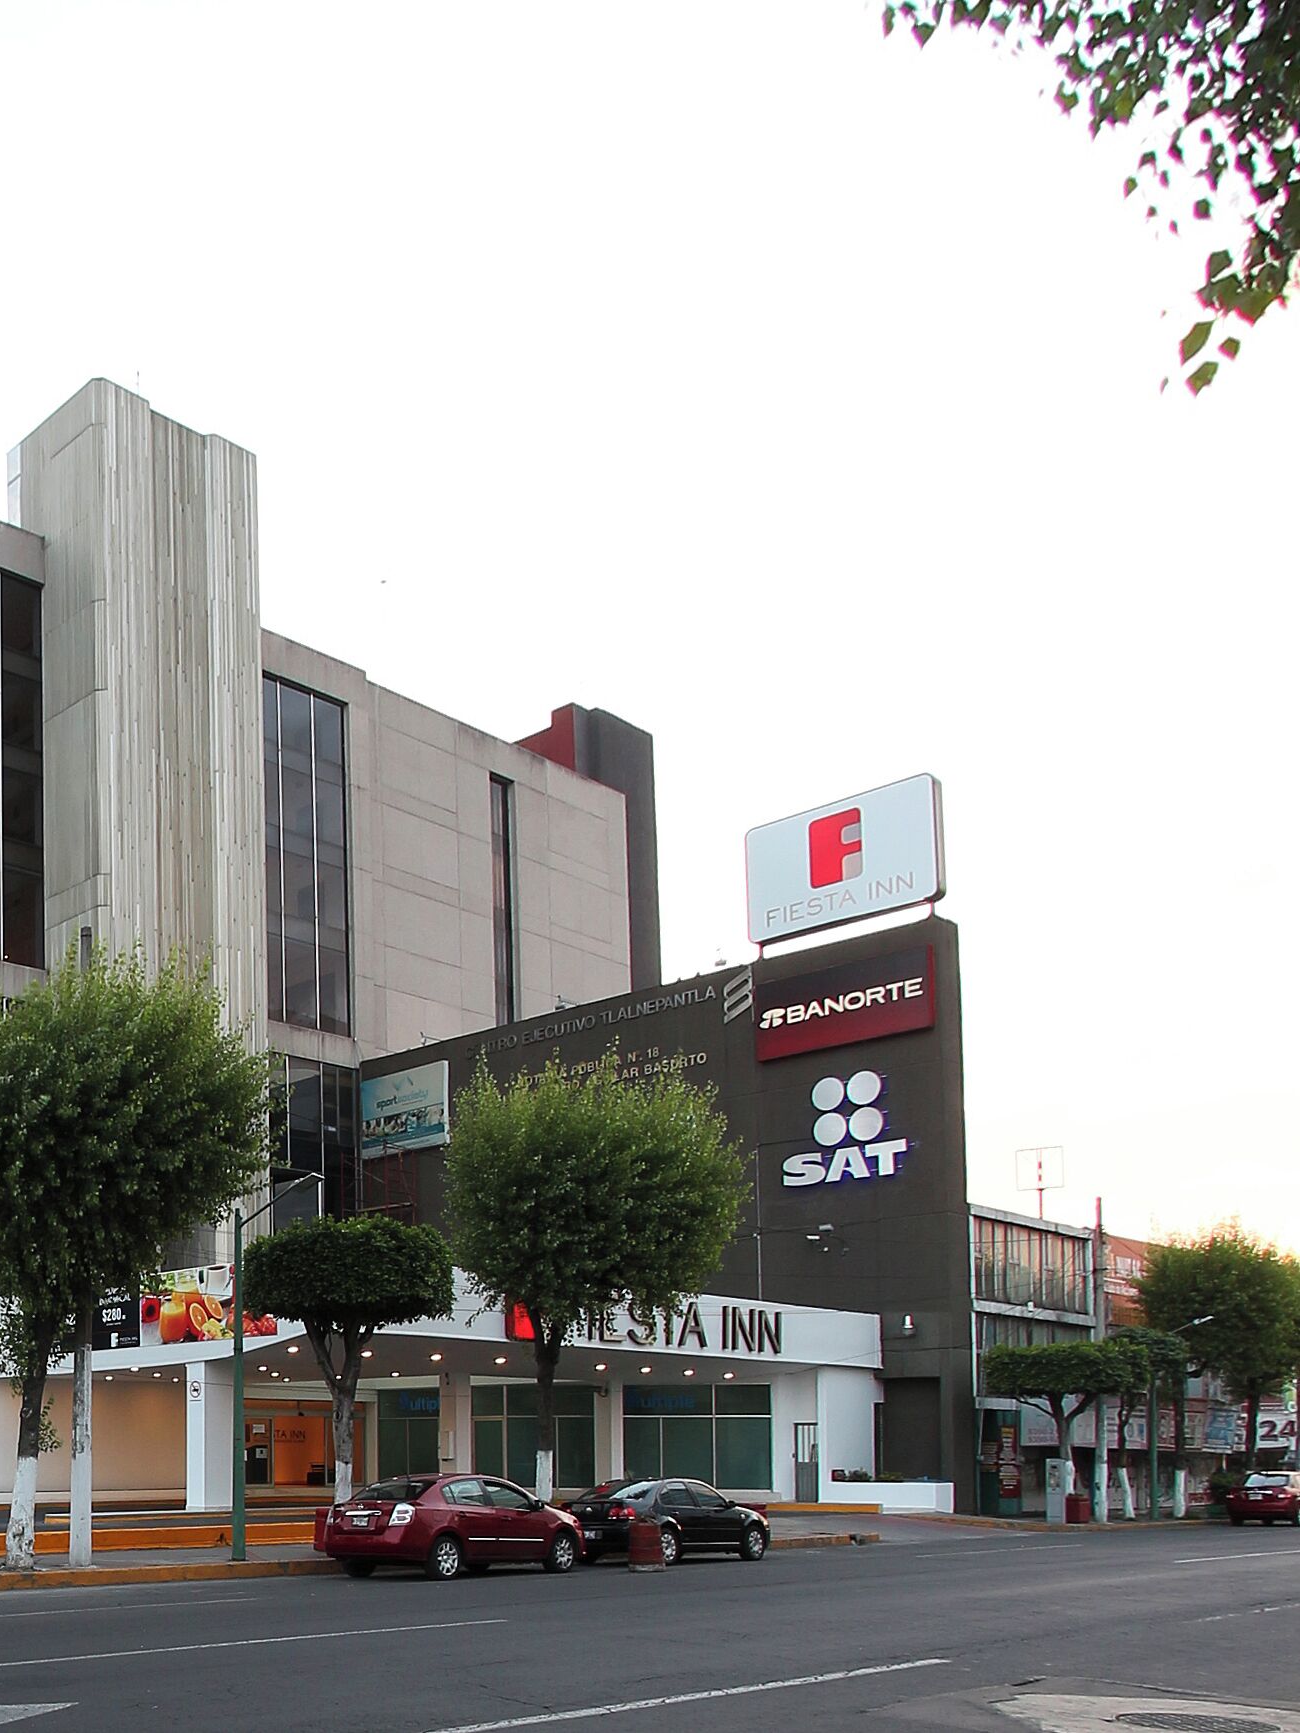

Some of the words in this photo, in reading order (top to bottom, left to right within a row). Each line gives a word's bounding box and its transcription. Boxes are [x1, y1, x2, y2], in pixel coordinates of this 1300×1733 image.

[766, 889, 857, 928] FIESTA
[868, 871, 914, 900] INN
[522, 1015, 596, 1046] EJECUTIVO
[599, 986, 717, 1026] TLALNEPANTLA
[786, 977, 924, 1025] BANORTE
[646, 1046, 660, 1060] 18
[782, 1138, 908, 1186] SAT
[584, 1301, 708, 1350] IESTA
[721, 1305, 783, 1355] INN
